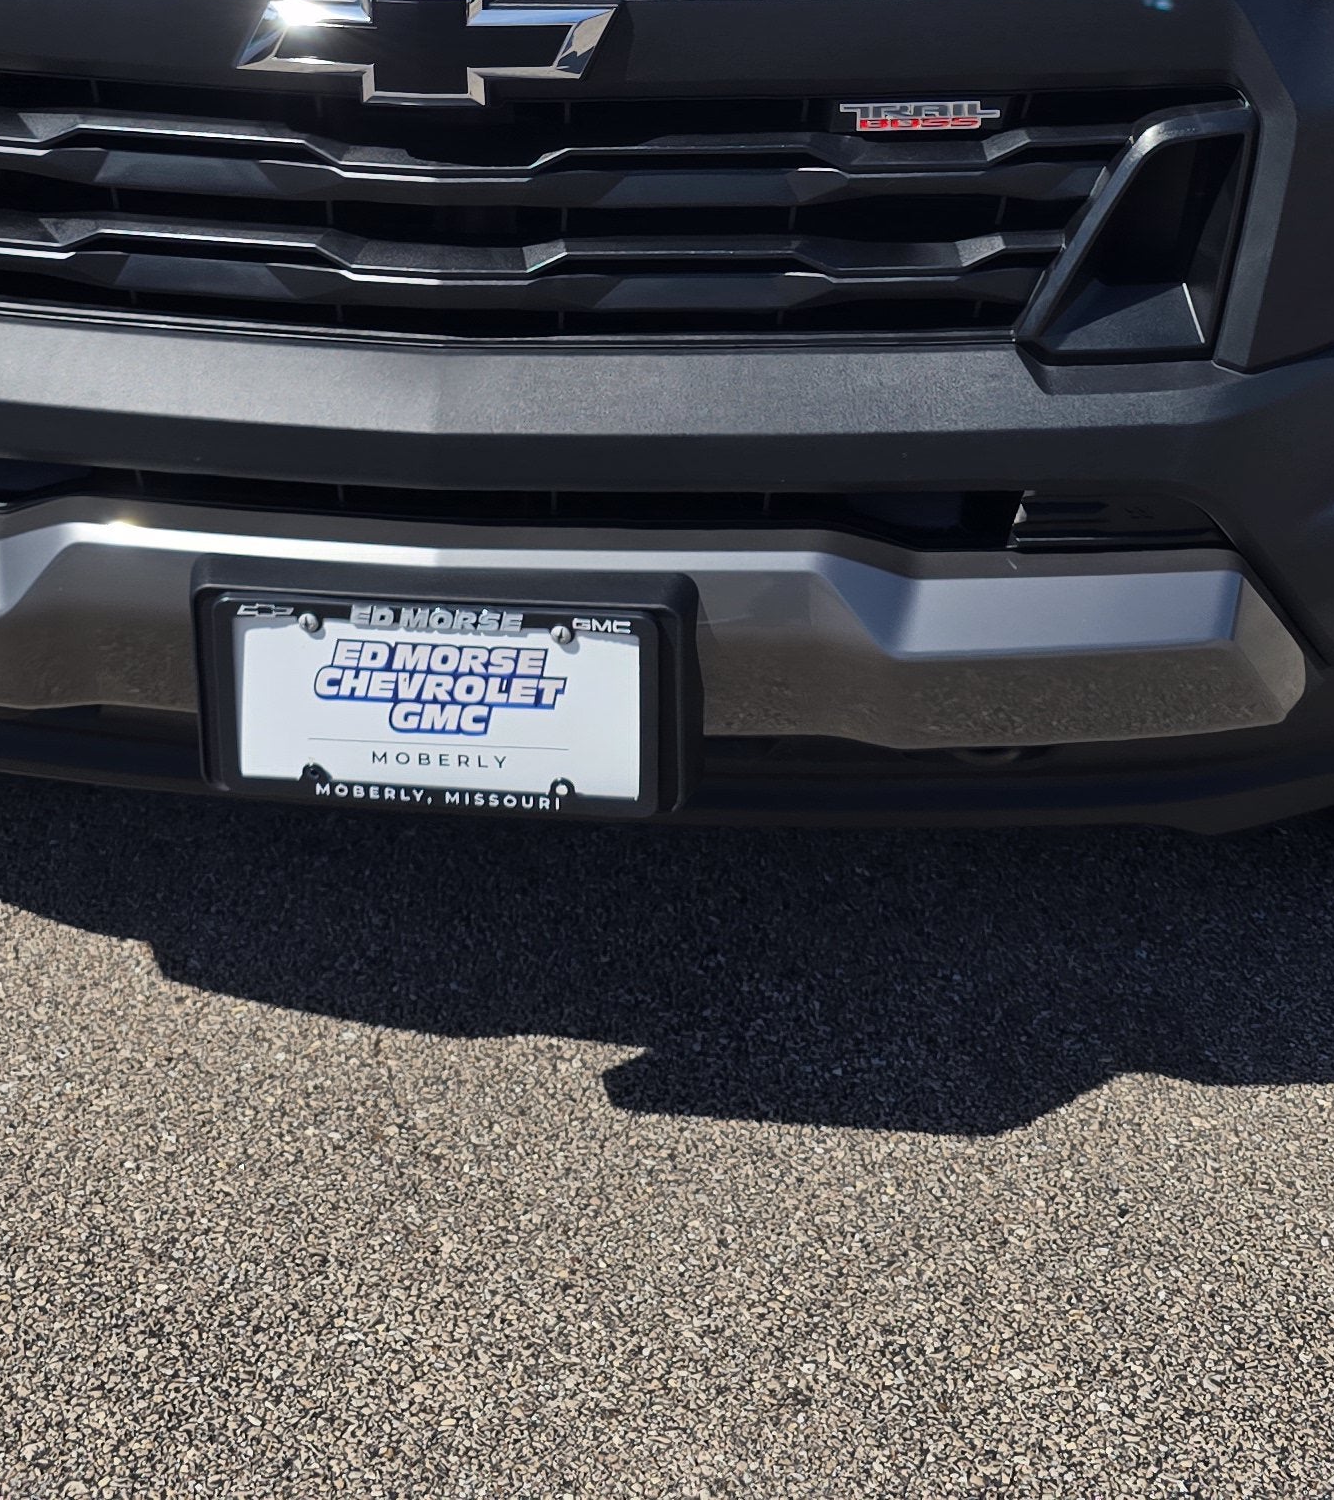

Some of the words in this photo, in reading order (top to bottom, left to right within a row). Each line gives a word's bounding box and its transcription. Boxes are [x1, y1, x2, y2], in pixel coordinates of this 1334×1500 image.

[840, 101, 1000, 119] TRAIL
[857, 117, 982, 131] BOSS
[350, 605, 394, 627] ED
[399, 607, 524, 632] MORSE
[572, 617, 632, 635] GMC
[331, 639, 391, 670] ED
[391, 643, 548, 677] MORSE
[314, 666, 567, 709] CHEVROLET
[389, 702, 492, 735] GMC
[372, 751, 508, 769] MOBERLY
[445, 791, 560, 811] MISSOURI
